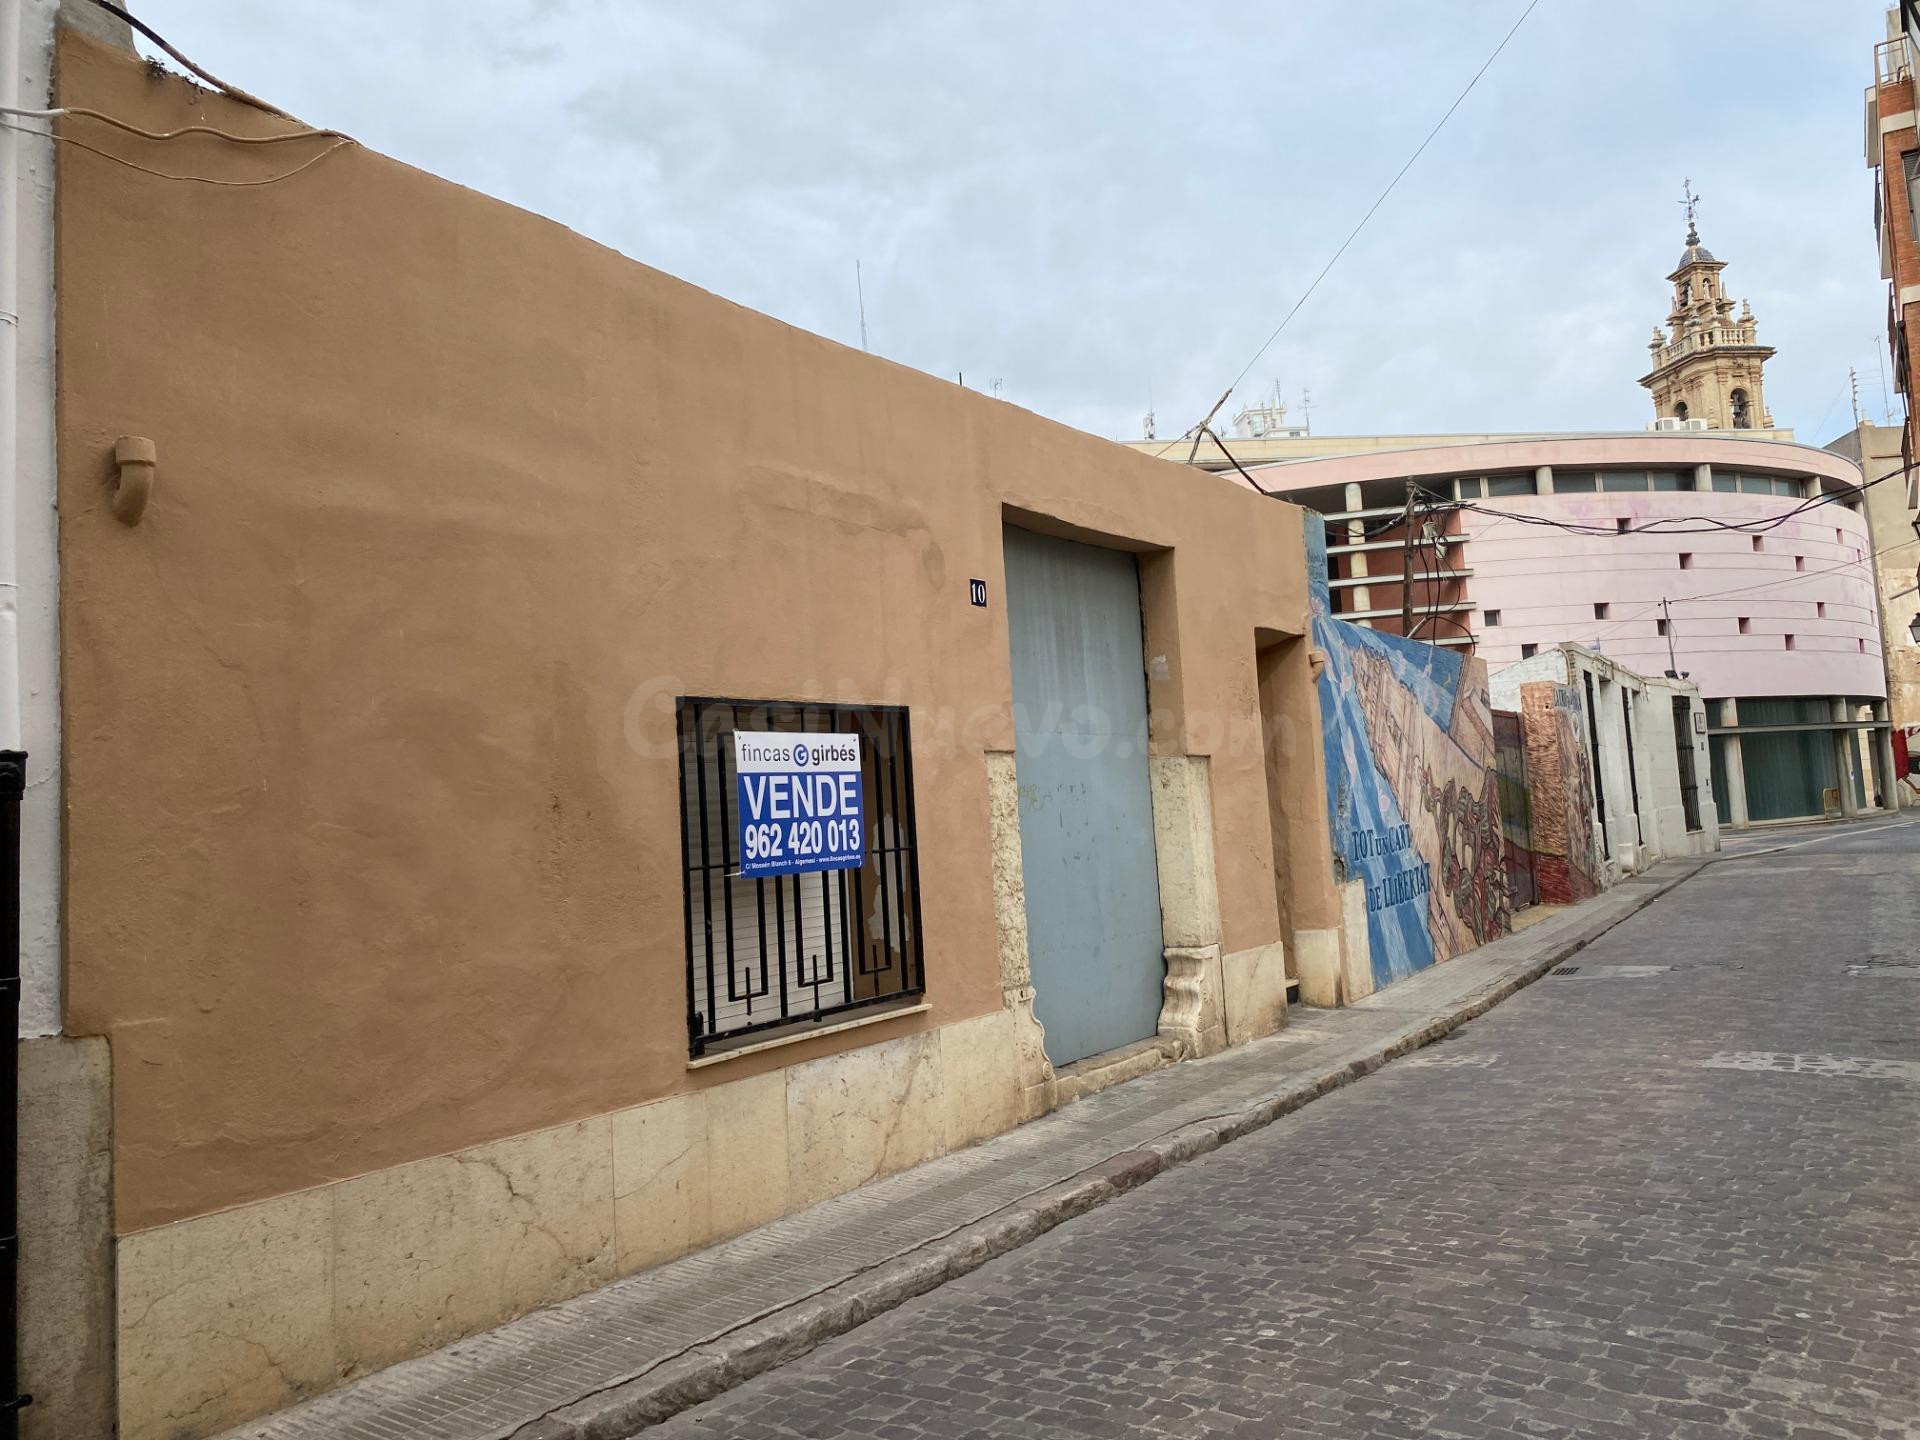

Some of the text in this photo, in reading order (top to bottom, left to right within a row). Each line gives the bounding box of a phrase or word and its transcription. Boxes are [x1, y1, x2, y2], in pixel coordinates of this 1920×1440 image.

[972, 583, 986, 603] 10
[742, 744, 790, 762] fincas
[812, 744, 856, 766] girbés
[743, 774, 859, 820] VENDE
[745, 818, 861, 859] 962 420 013
[1352, 829, 1374, 861] TOT
[1388, 824, 1411, 853] CANT
[1368, 886, 1382, 912] DE
